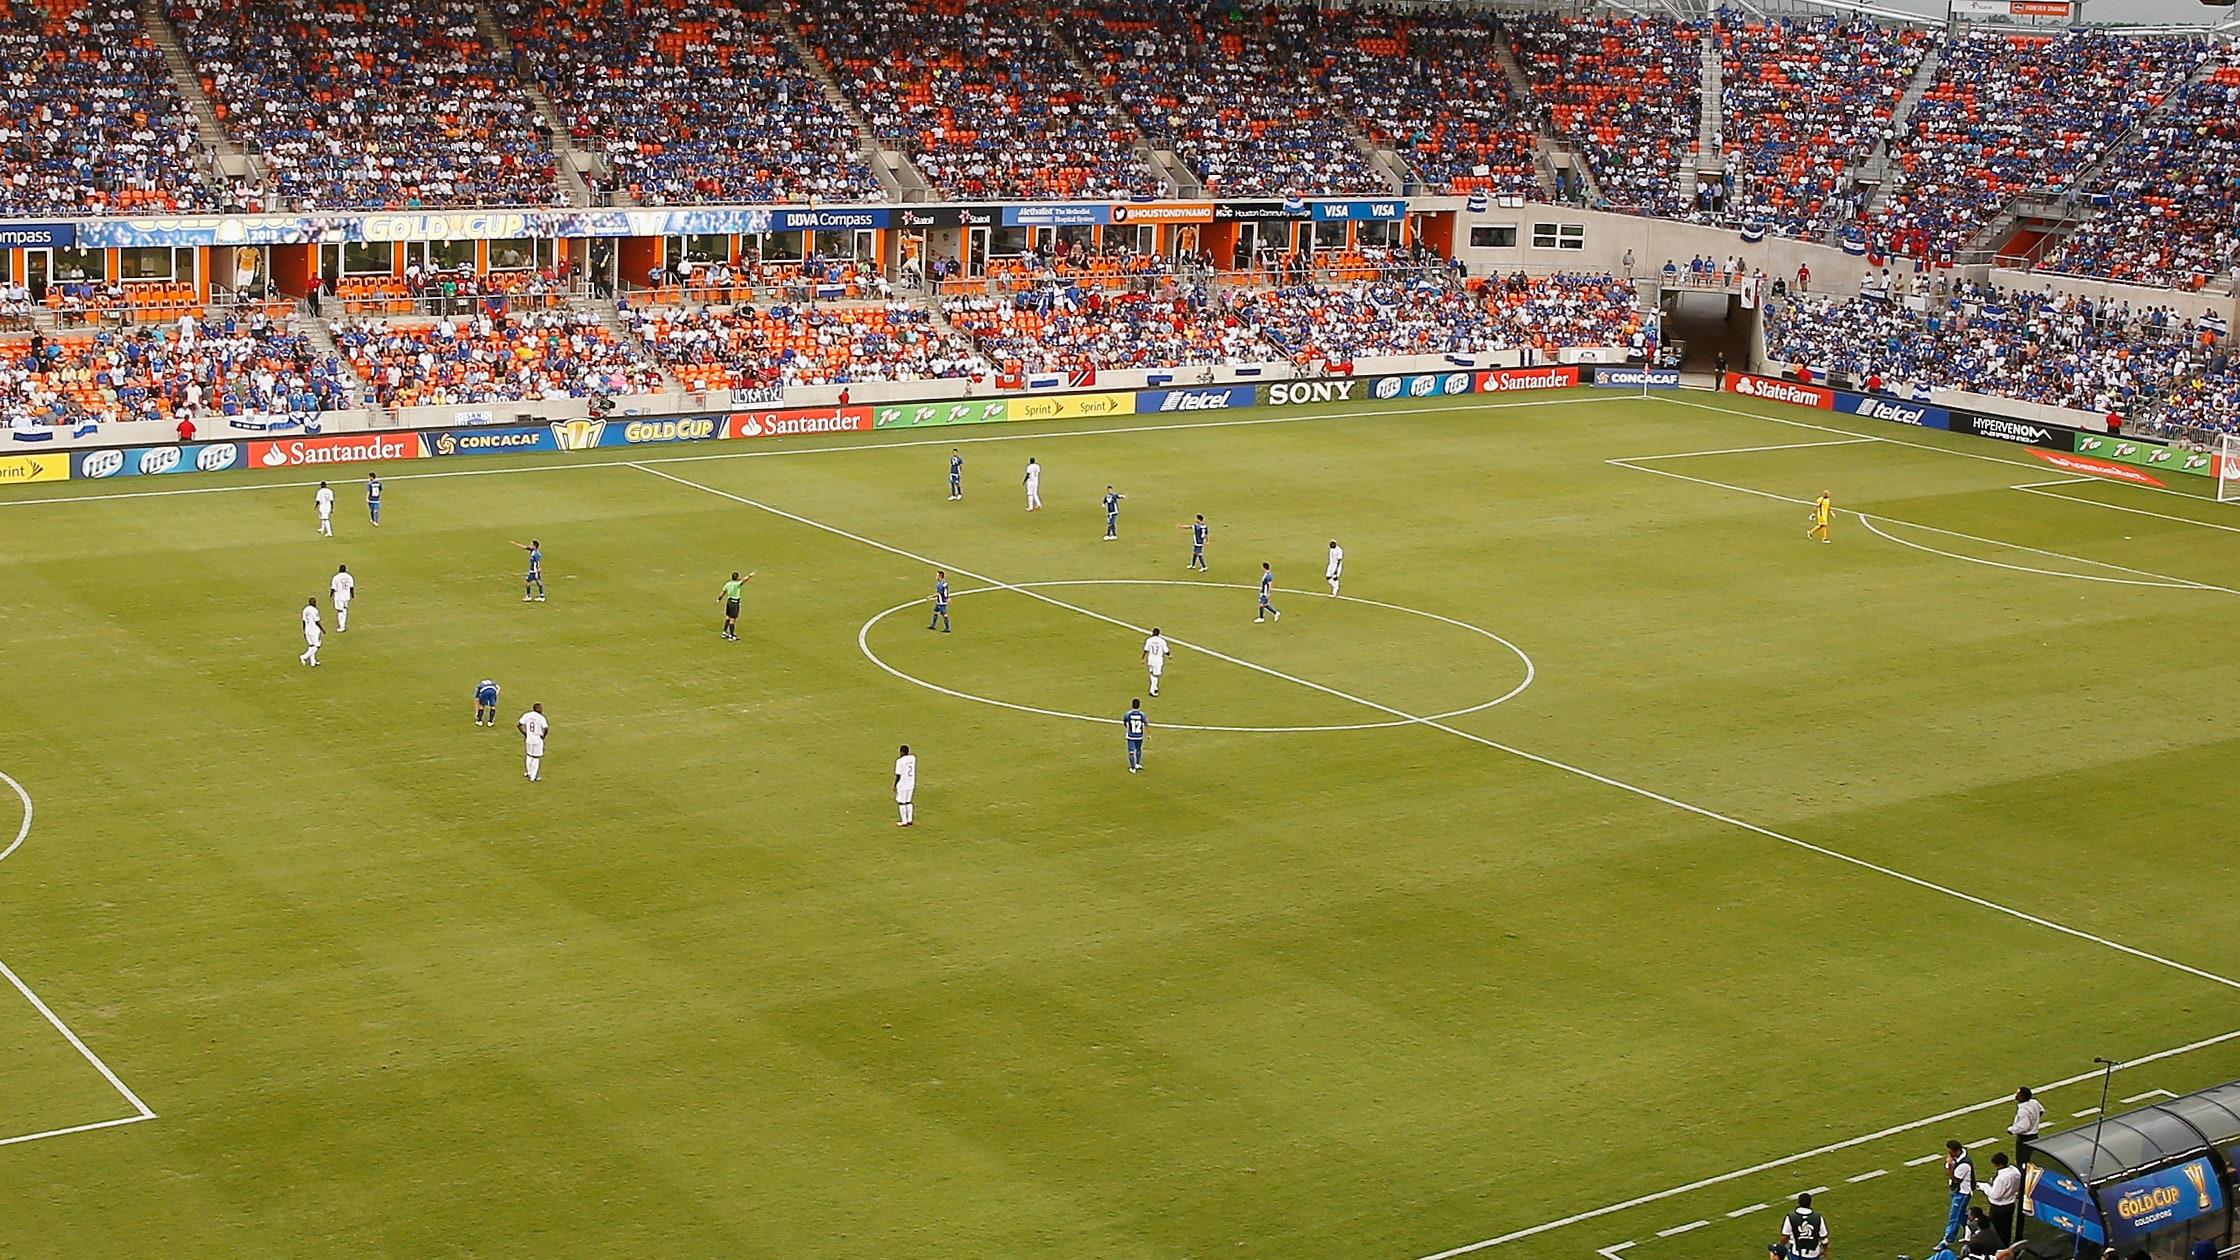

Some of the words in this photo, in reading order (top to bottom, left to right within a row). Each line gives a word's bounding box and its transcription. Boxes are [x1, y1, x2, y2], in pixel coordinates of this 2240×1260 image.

[1128, 208, 1210, 219] @HOUSTONDYNAMO
[1324, 205, 1348, 217] VISA
[1371, 204, 1395, 217] VISA
[363, 214, 449, 241] GOLD
[464, 213, 524, 240] CUP
[787, 213, 819, 226] BBVA
[820, 212, 873, 228] Compass
[970, 215, 991, 224] Statoil
[251, 230, 279, 242] 2013
[1499, 369, 1570, 390] Santander
[1611, 373, 1678, 384] CONCACAF
[1178, 390, 1232, 411] telcel
[1268, 380, 1356, 406] SONY
[1754, 379, 1819, 407] StateFarm
[1025, 404, 1052, 417] Sprint
[1080, 400, 1107, 413] Sprint
[1873, 401, 1923, 426] telcel
[764, 409, 861, 434] Santander
[1973, 416, 2053, 440] HYPERVENOM
[624, 421, 677, 443] GOLD
[676, 417, 714, 439] CUP
[459, 434, 540, 449] CONCACAF
[290, 436, 405, 465] Santander
[530, 721, 535, 733] 8
[1130, 719, 1142, 734] 12
[907, 765, 913, 777] 2
[2118, 1196, 2155, 1219] GOLD
[2152, 1184, 2180, 1208] CUP
